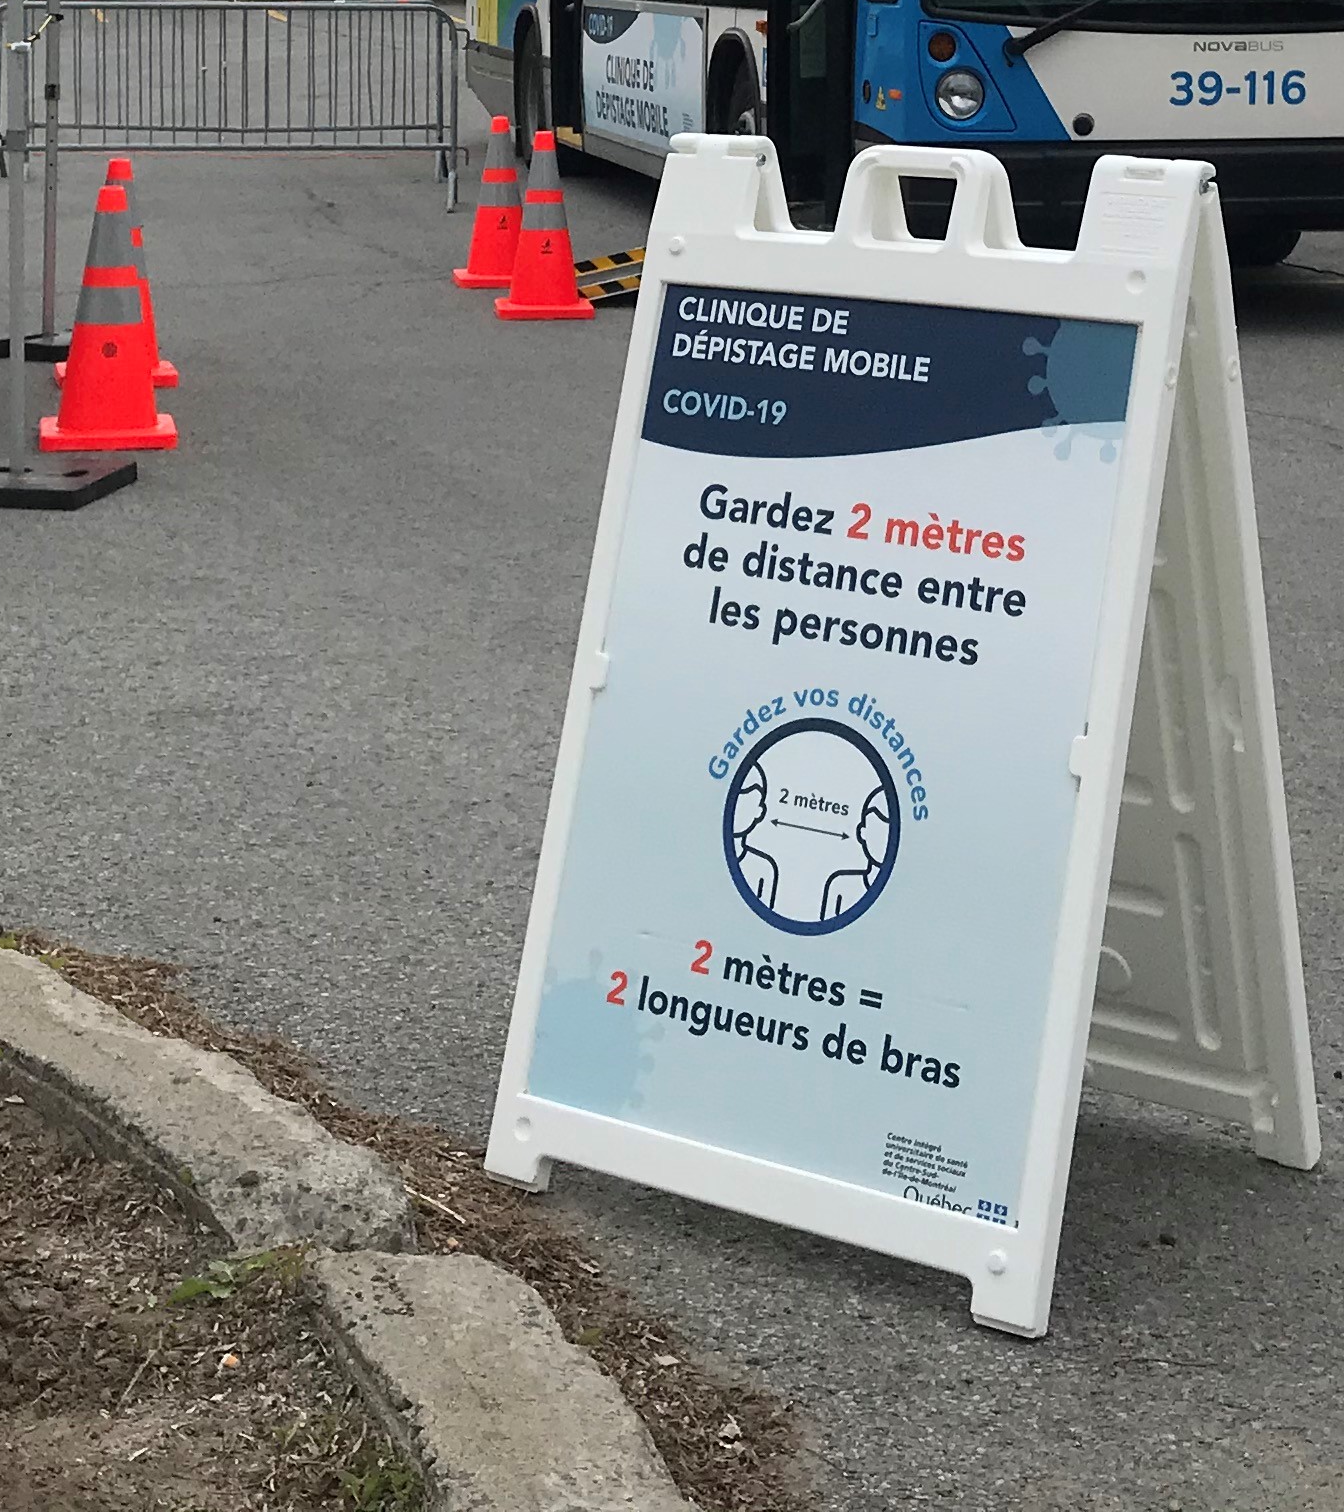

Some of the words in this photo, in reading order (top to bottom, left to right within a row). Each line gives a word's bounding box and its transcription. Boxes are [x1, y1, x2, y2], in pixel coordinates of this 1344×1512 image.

[606, 54, 641, 89] CLINIQUE
[642, 60, 655, 92] DE
[1169, 70, 1306, 106] 39-116
[595, 85, 636, 129] DÉPISTAGE
[636, 101, 669, 138] MOBILE
[678, 296, 803, 333] CLINIQUE
[811, 307, 850, 336] DE
[672, 330, 816, 371] DÉPISTAGE
[823, 347, 931, 383] MOBILE
[662, 388, 788, 426] COVID-19
[699, 483, 834, 536] Gardez
[846, 503, 870, 540] 2
[884, 511, 1026, 562] mètres
[683, 532, 729, 572] de
[742, 541, 903, 598] distance
[918, 573, 1026, 616] entre
[709, 586, 760, 631] les
[773, 606, 979, 666] personnes
[708, 696, 787, 780] Gardez
[793, 688, 840, 707] vos
[848, 693, 929, 821] distances
[779, 788, 789, 804] 2
[794, 793, 850, 816] mètres
[690, 940, 714, 974] 2
[723, 951, 847, 1007] mètres
[858, 988, 884, 1011] =
[605, 970, 628, 1005] 2
[637, 976, 809, 1051] longueurs
[821, 1023, 868, 1065] de
[880, 1035, 962, 1089] bras
[887, 1132, 912, 1145] Centre
[905, 1156, 935, 1170] services
